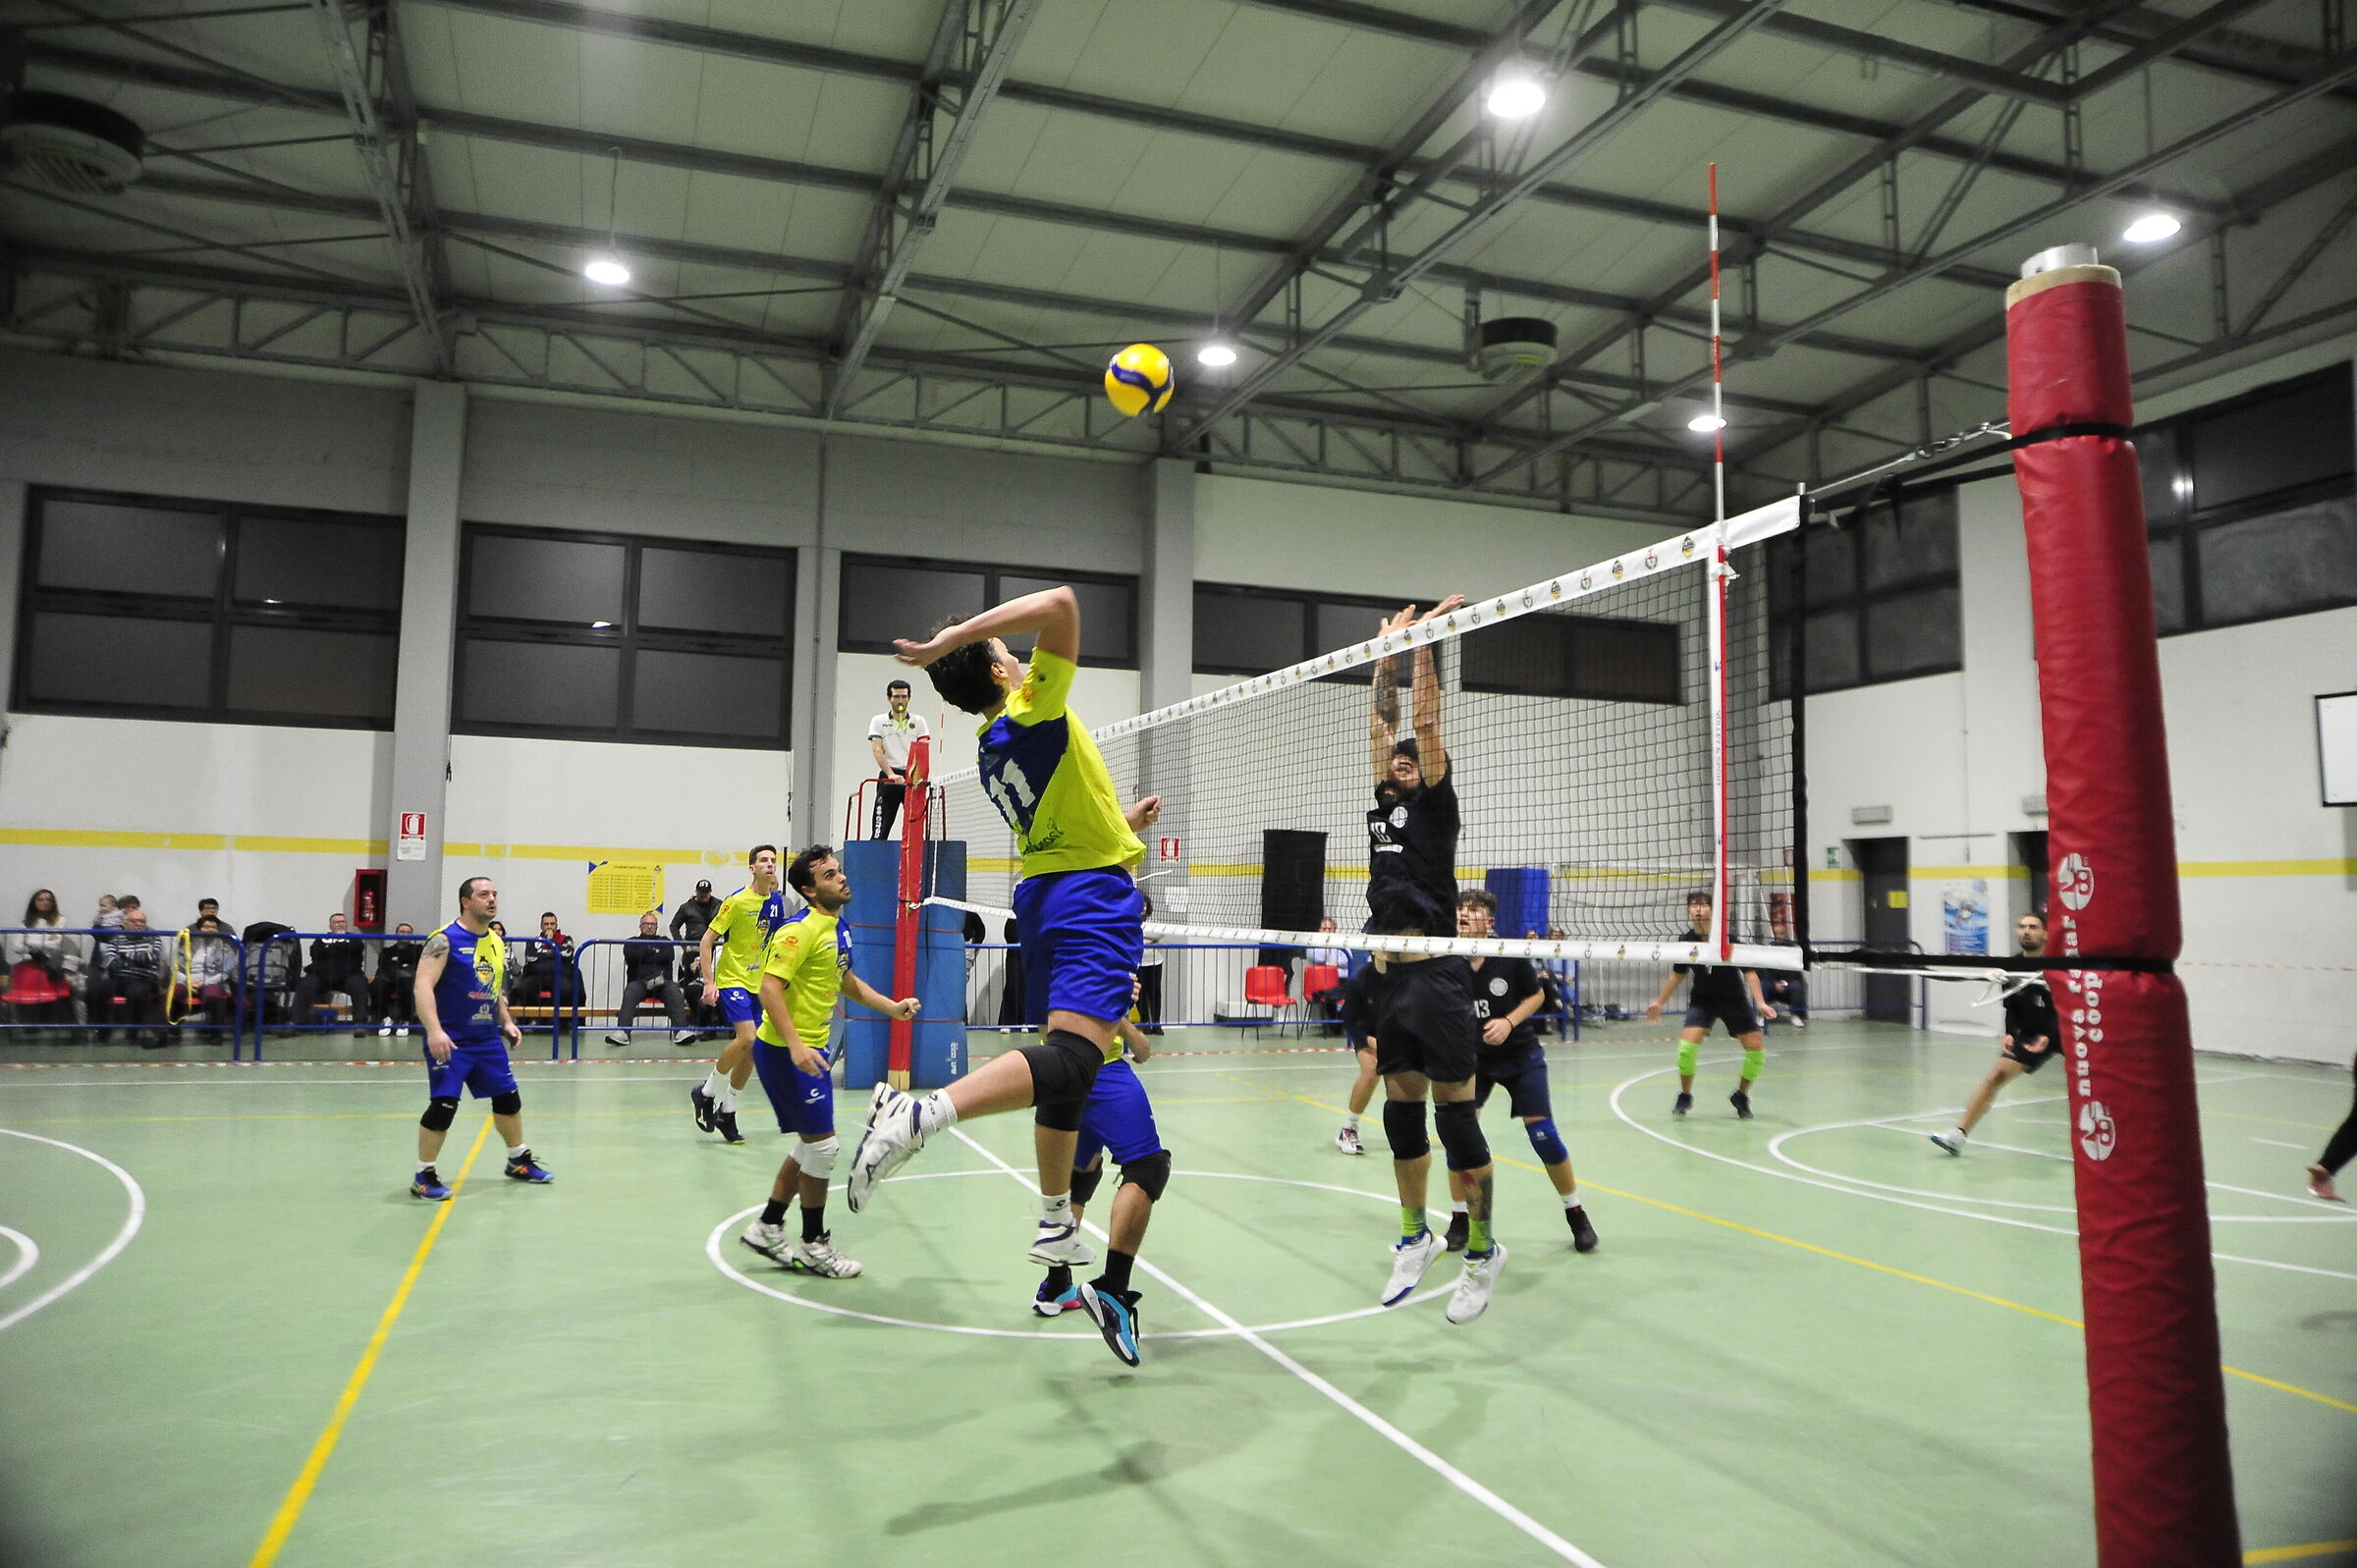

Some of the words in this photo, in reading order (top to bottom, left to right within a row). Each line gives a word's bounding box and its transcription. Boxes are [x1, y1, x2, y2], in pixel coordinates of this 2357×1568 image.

[989, 758, 1036, 823] 11
[770, 904, 778, 917] 21
[491, 945, 497, 956] 1
[1474, 999, 1491, 1018] 13
[2084, 971, 2104, 1043] coop
[2073, 1009, 2092, 1097] nuova
